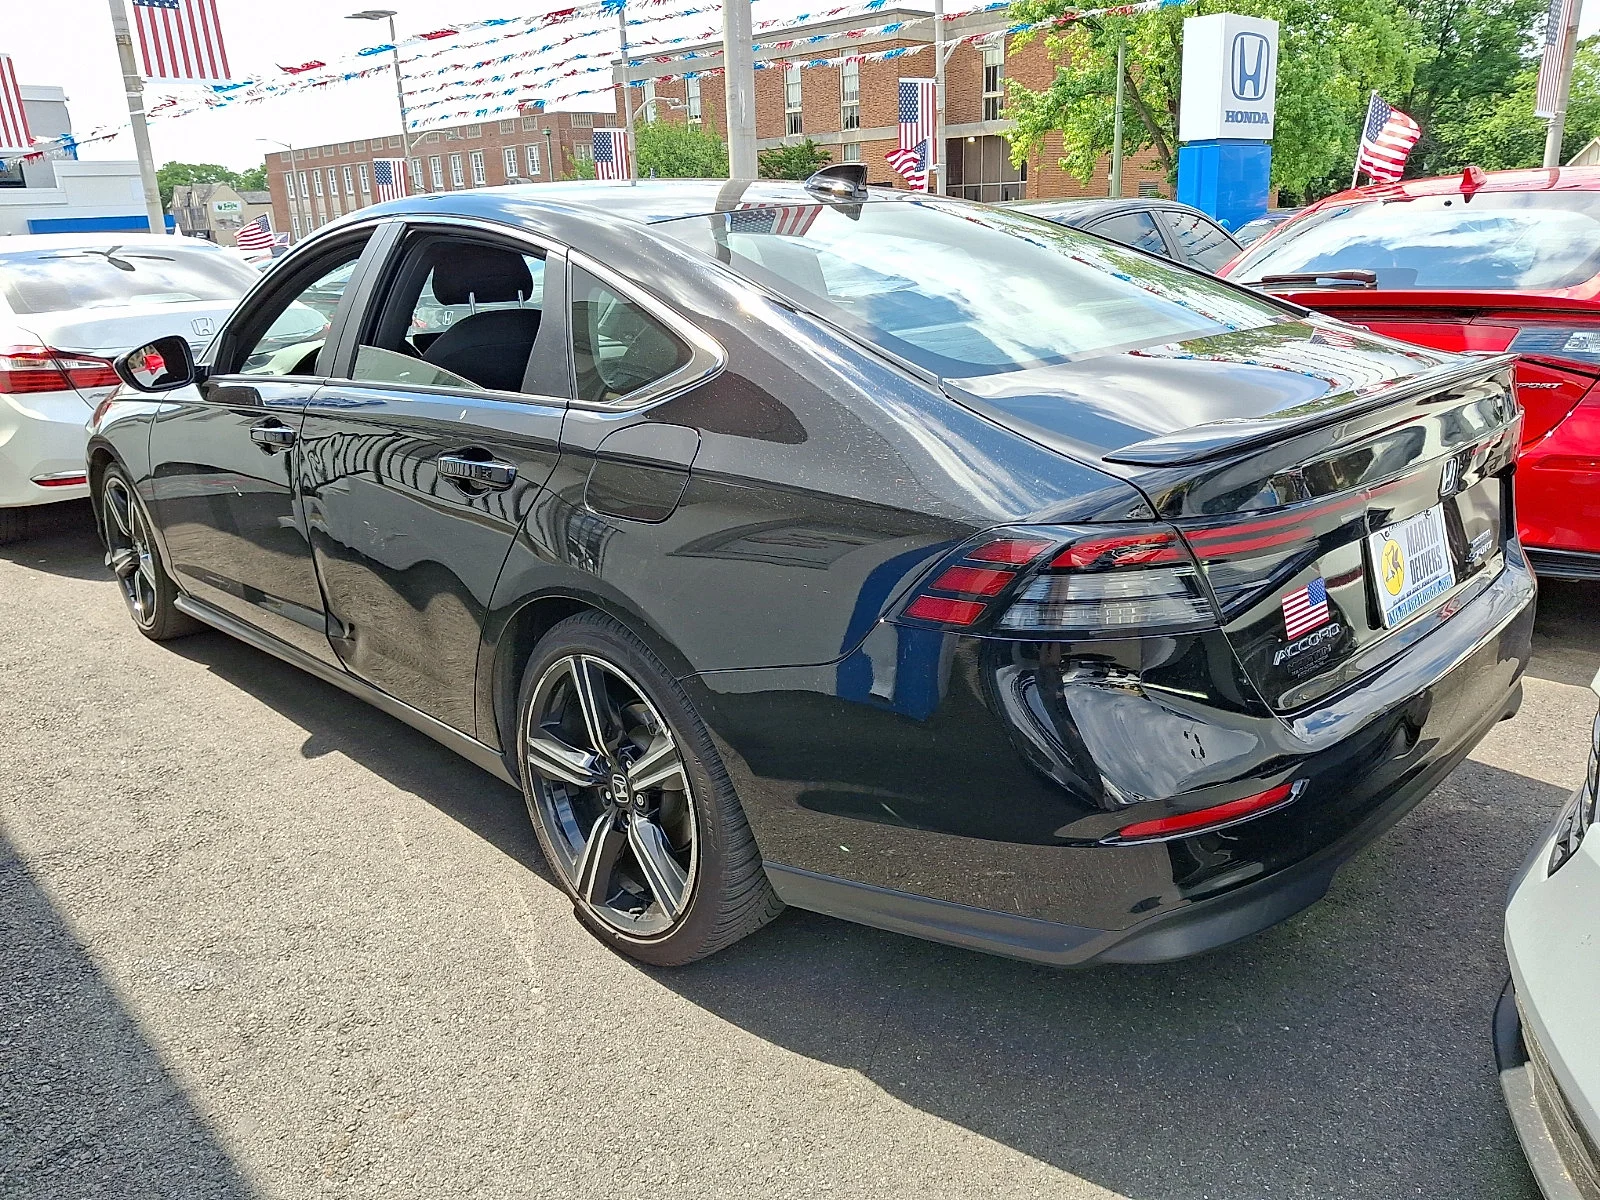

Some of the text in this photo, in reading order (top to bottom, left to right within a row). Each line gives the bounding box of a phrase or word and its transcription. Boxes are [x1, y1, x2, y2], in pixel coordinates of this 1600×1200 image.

[1225, 110, 1269, 124] HONDA
[1406, 513, 1439, 557] MARTIN
[1465, 540, 1493, 562] SPORT
[1409, 545, 1442, 585] DELIVERS
[1273, 623, 1340, 666] ACCORD
